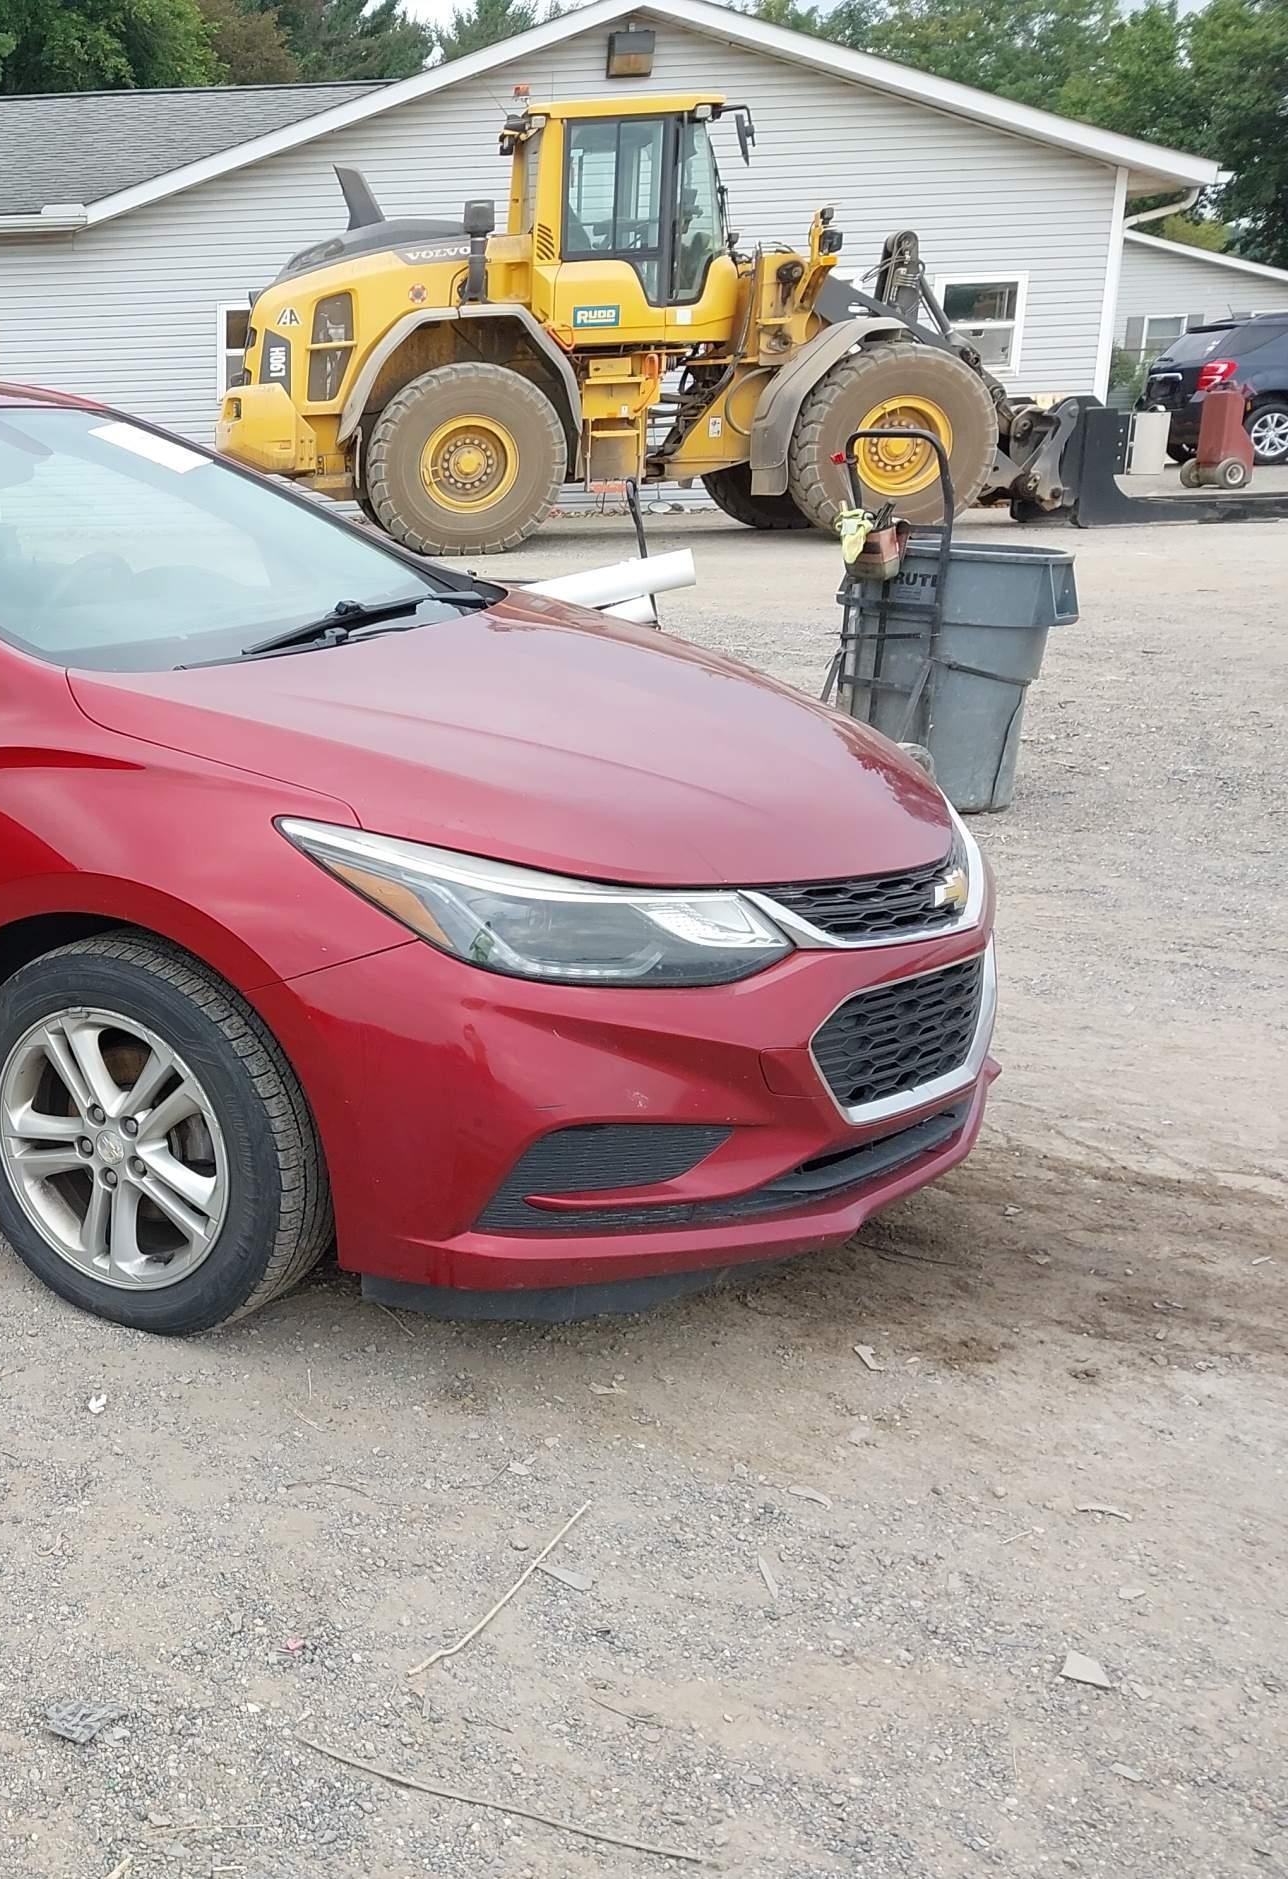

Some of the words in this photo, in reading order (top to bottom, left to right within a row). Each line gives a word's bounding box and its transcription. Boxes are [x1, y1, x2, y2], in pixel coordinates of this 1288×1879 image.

[405, 246, 471, 260] VOLVO
[577, 309, 616, 324] RUDD
[269, 346, 286, 377] L90H
